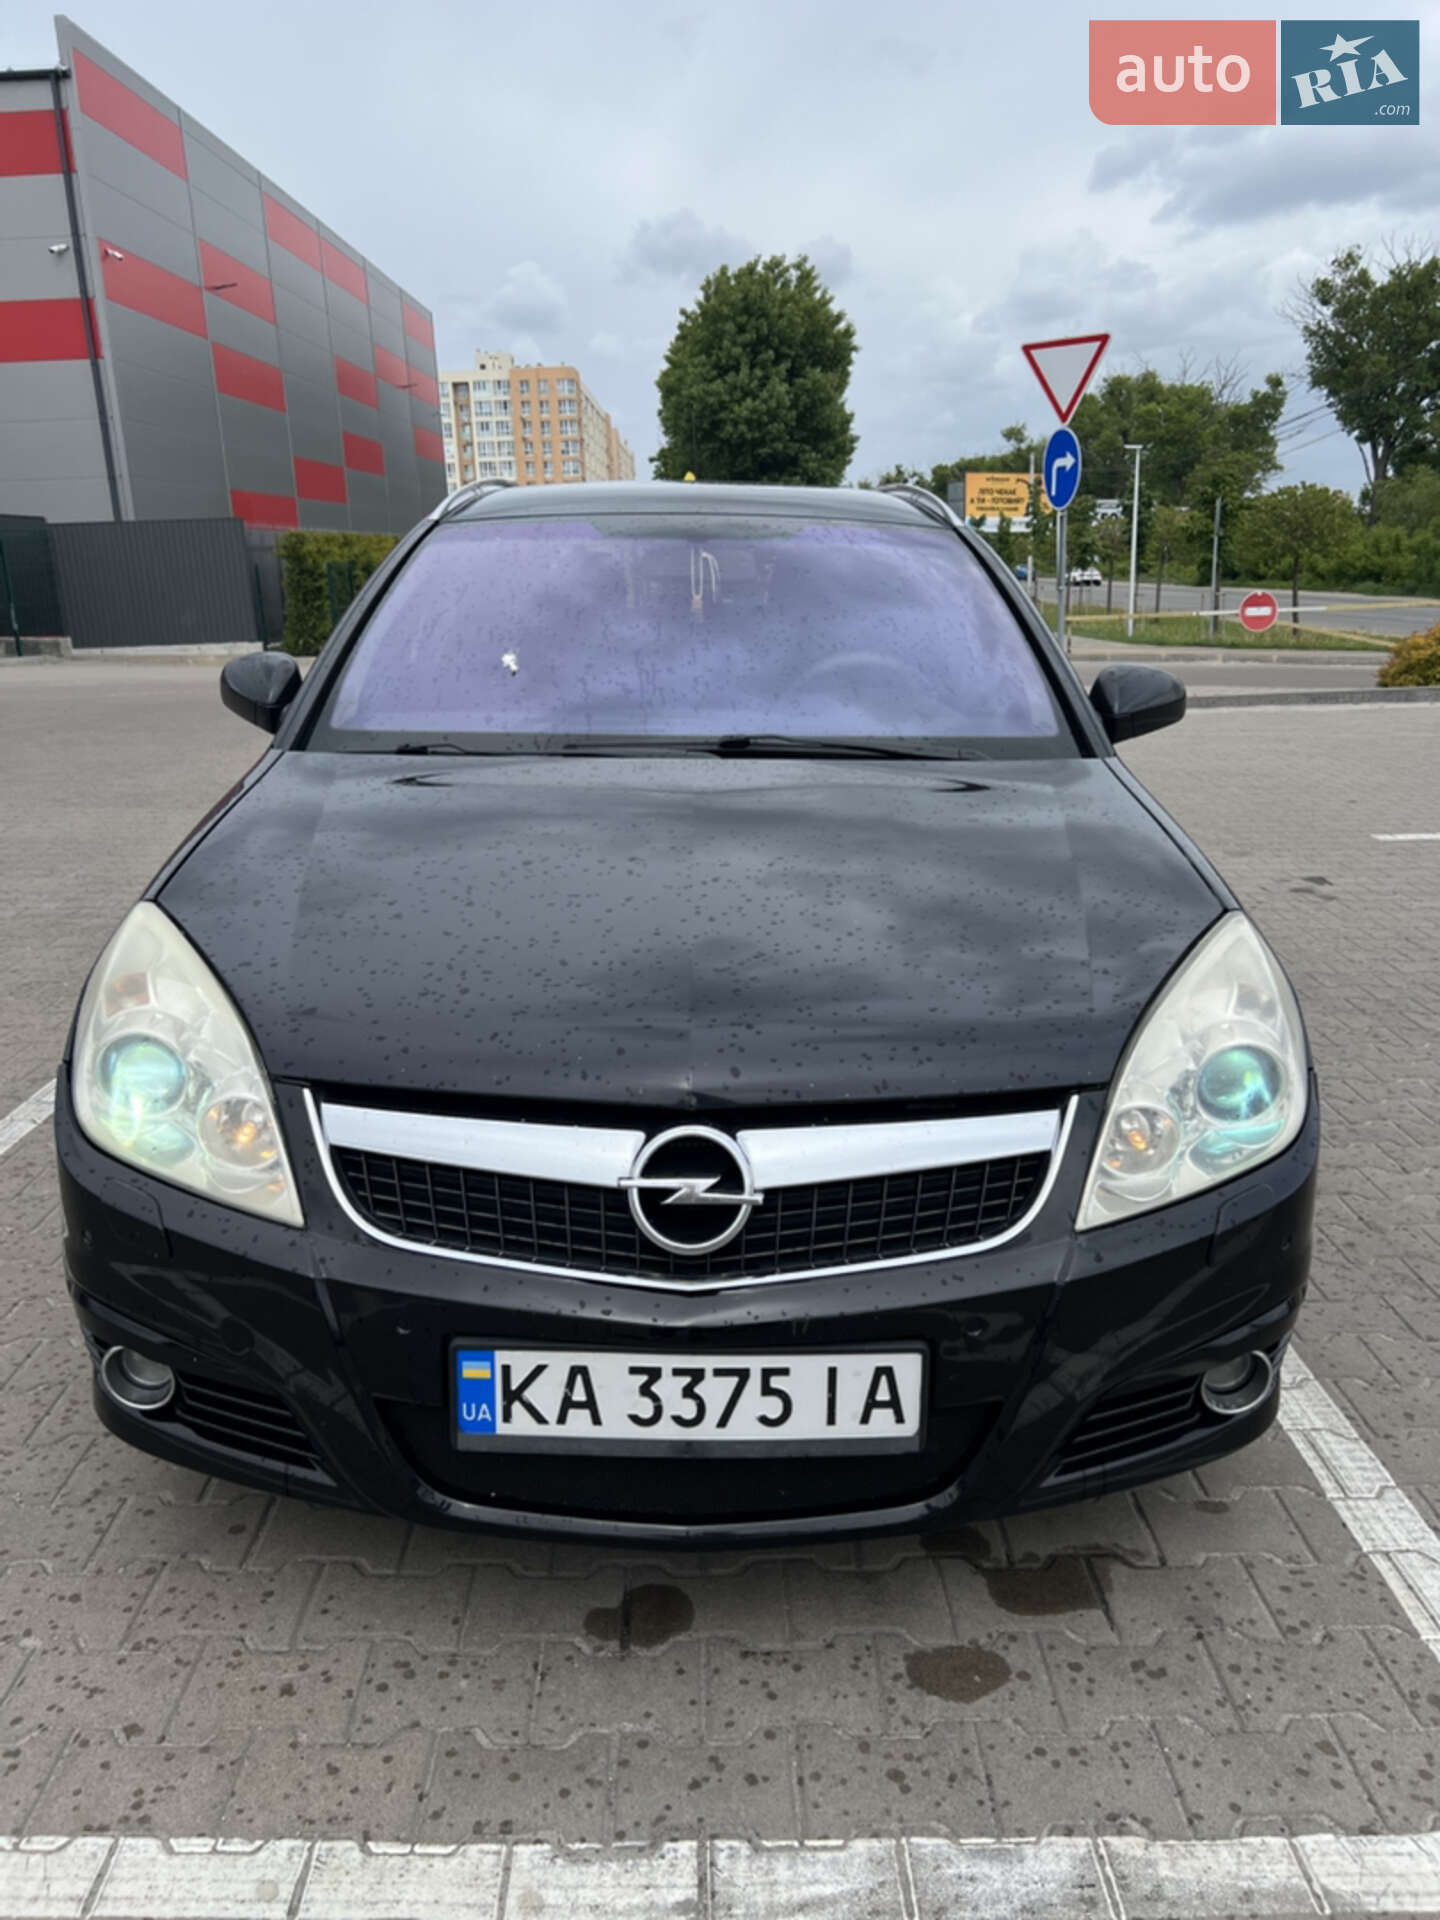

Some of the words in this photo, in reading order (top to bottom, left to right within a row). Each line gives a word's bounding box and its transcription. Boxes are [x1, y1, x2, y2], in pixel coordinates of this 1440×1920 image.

[462, 1403, 492, 1422] UA
[500, 1364, 603, 1426] KA
[626, 1366, 794, 1428] 3375
[826, 1366, 906, 1427] IA
